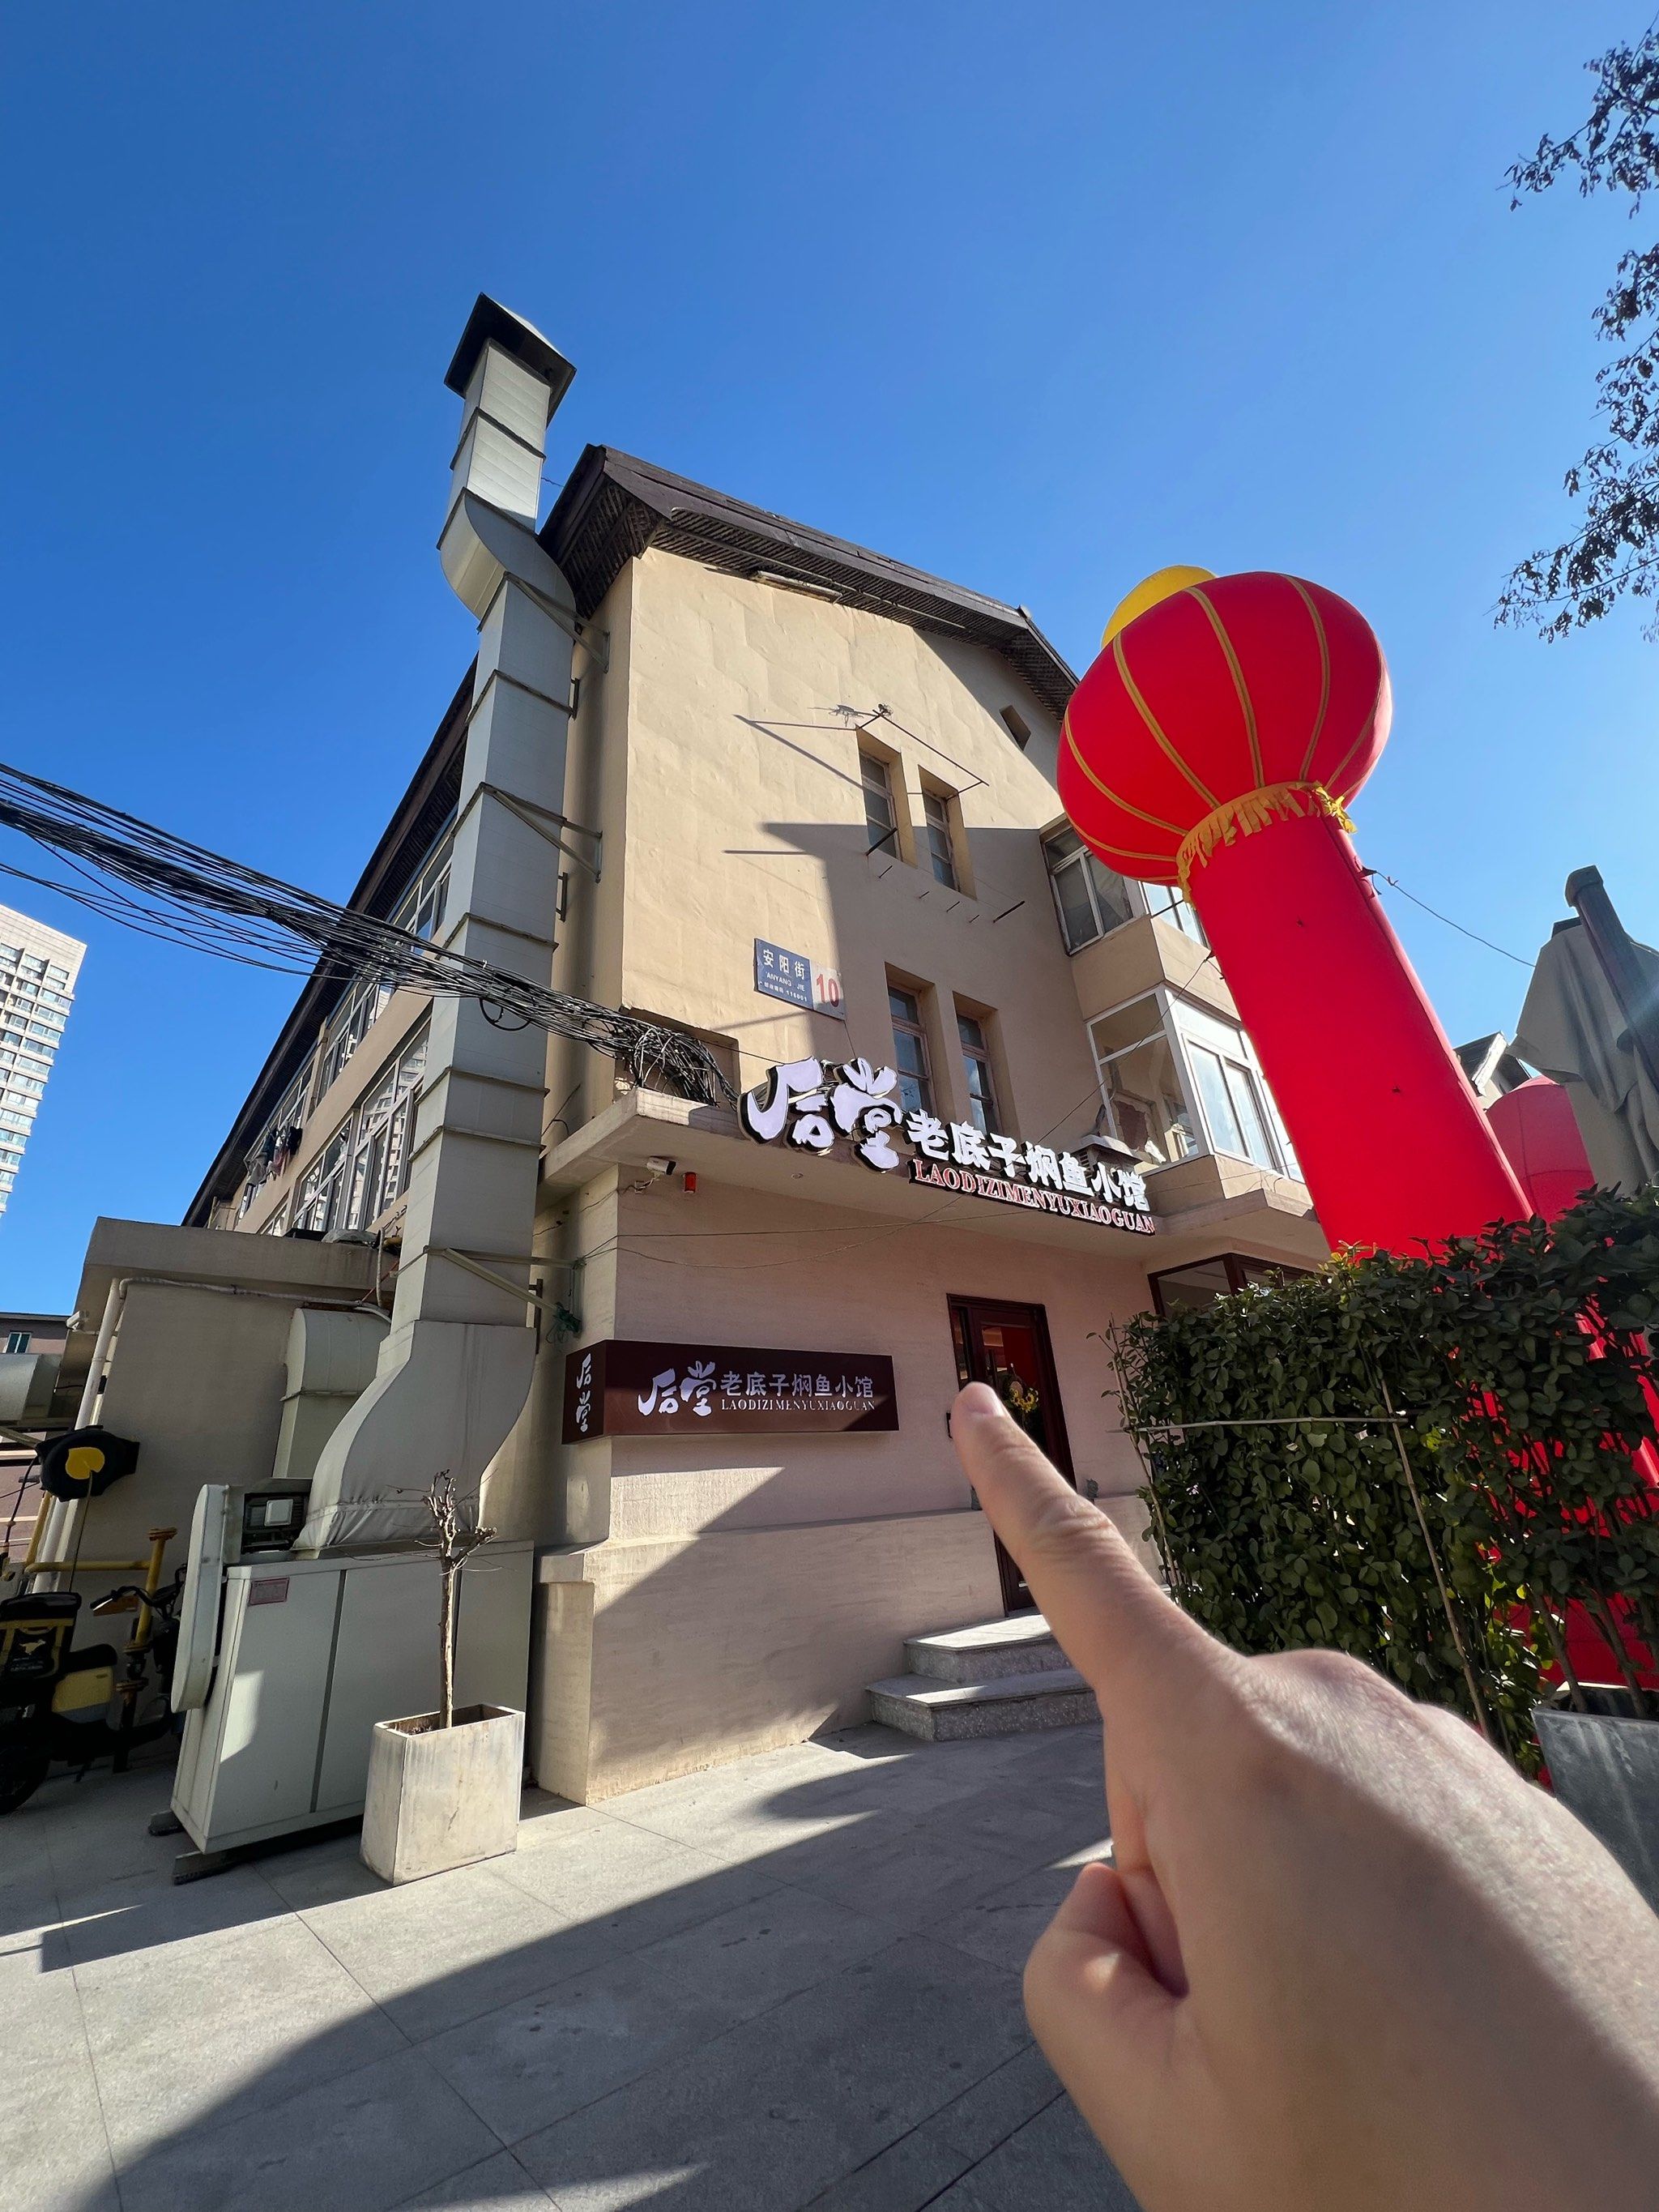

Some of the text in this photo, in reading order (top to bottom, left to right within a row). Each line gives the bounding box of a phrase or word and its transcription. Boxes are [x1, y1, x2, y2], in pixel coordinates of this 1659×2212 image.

[763, 949, 804, 980] 安阳街
[766, 972, 792, 987] ANYANG
[796, 983, 805, 992] JIE
[816, 973, 840, 1007] 10
[906, 1108, 1150, 1211] 老底子焖鱼小馆
[913, 1159, 1156, 1234] LAODIZIMENYUXIAOGUAN
[720, 1370, 874, 1399] 老底子焖鱼小馆
